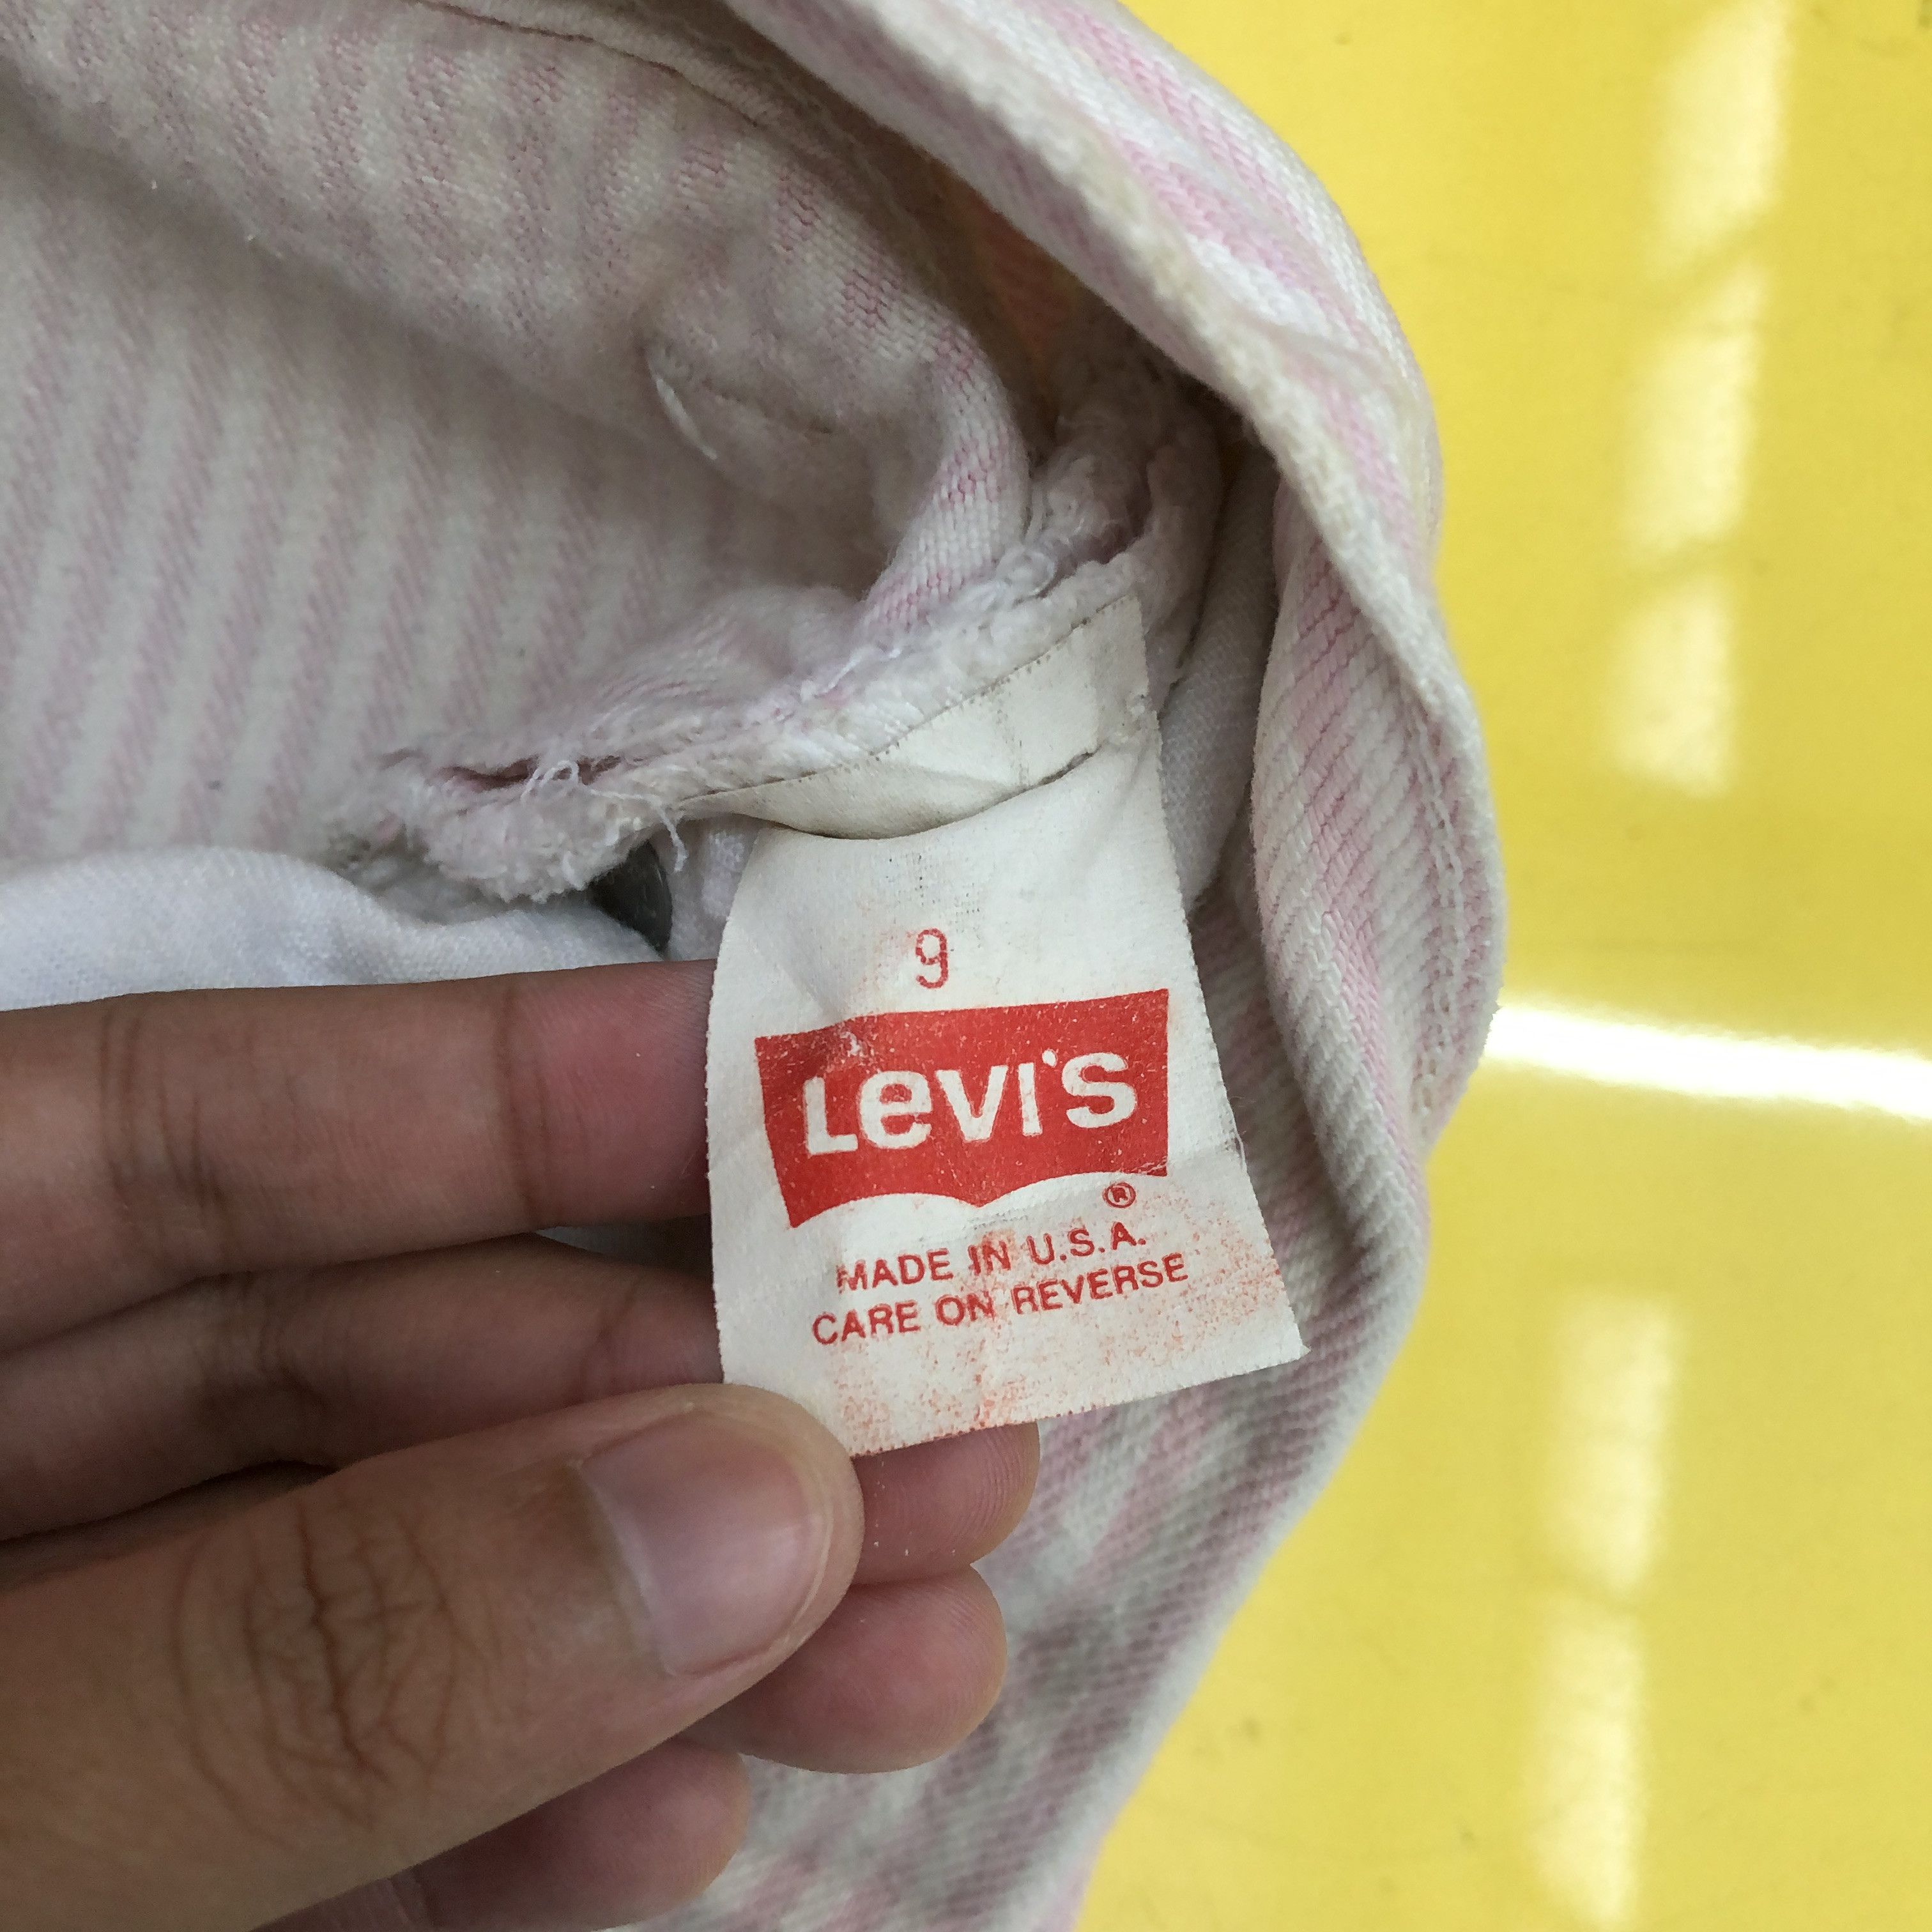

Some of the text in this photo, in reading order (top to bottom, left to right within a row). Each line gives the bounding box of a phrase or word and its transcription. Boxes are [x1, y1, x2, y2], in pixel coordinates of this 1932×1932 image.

[914, 928, 948, 988] 9
[836, 1222, 1146, 1294] MADE IN U.S.A.
[813, 1252, 1188, 1346] CARE ON REVERSE
